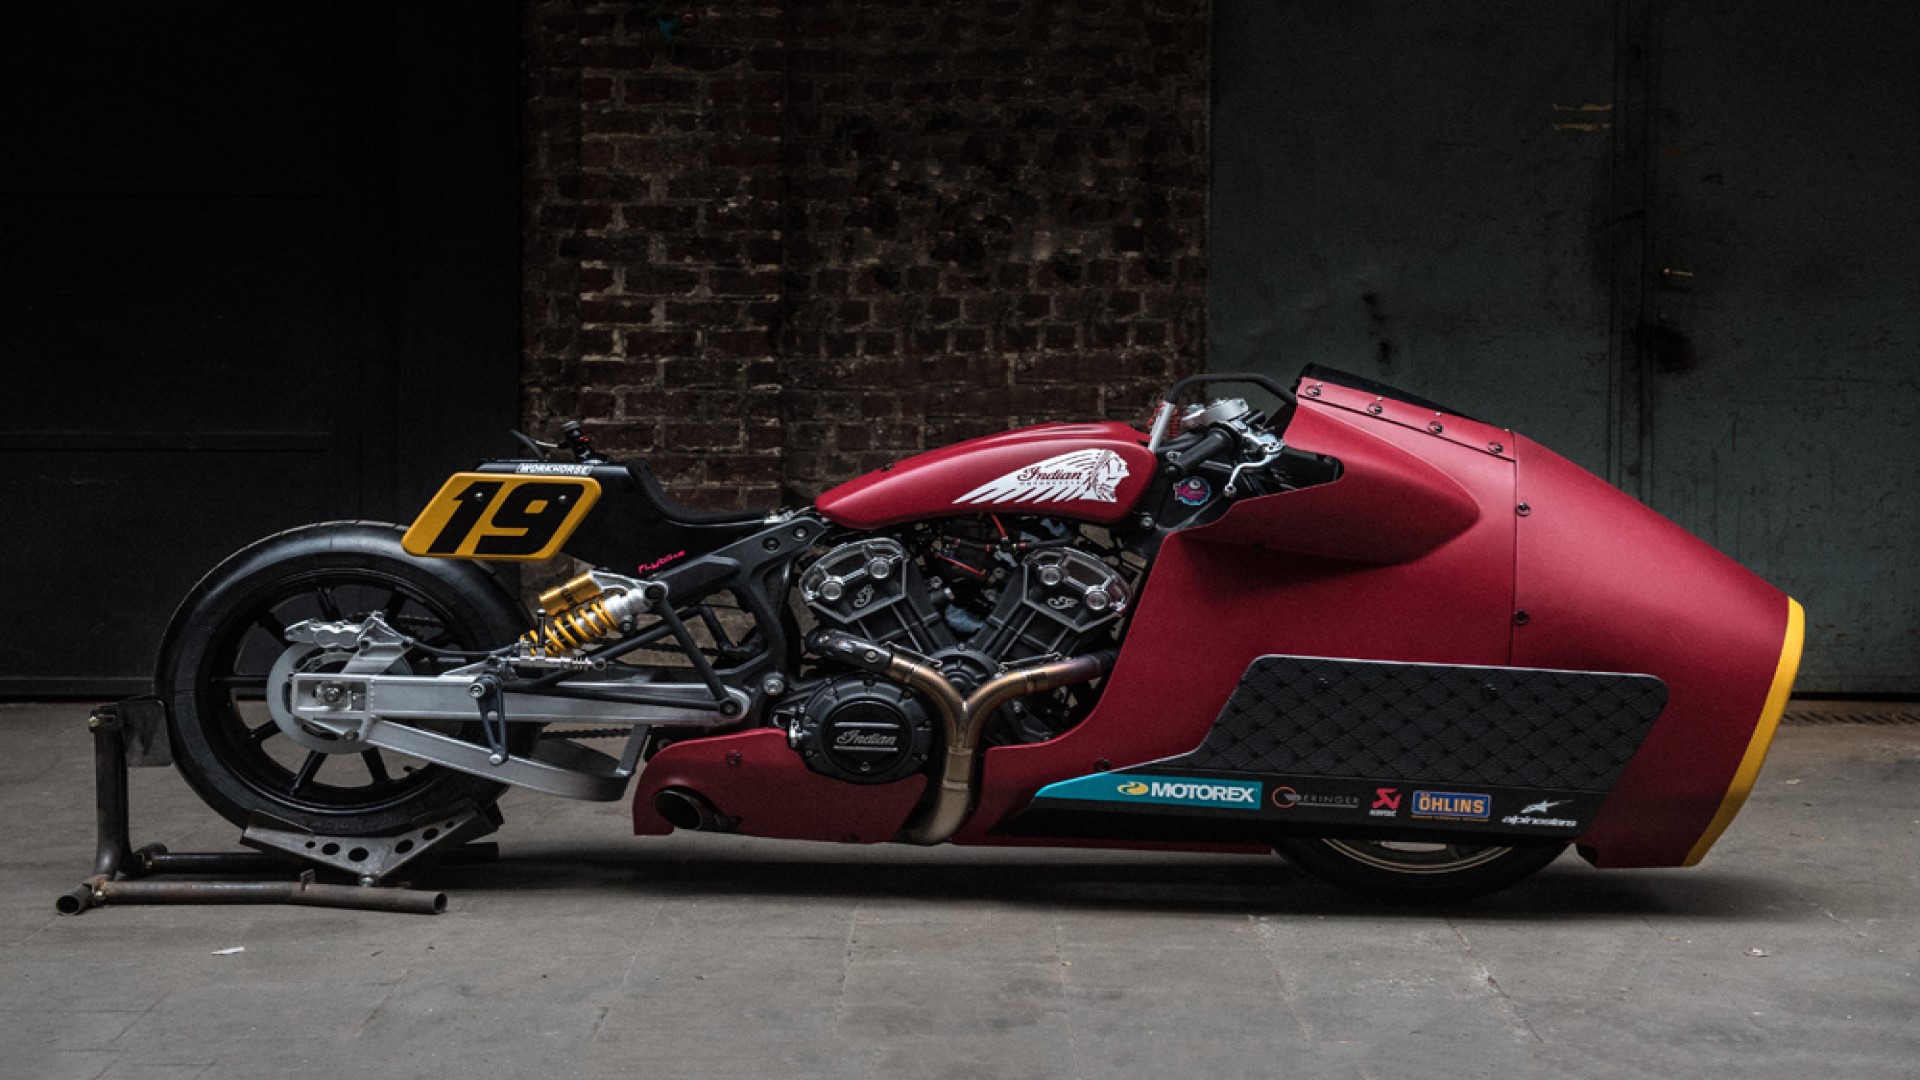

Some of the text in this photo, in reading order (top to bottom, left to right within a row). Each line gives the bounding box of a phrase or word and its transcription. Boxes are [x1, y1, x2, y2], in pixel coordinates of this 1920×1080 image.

[517, 464, 591, 476] WORKHORSE
[1017, 466, 1082, 481] Indian
[426, 481, 585, 555] 19
[836, 729, 898, 746] Indian
[1151, 781, 1255, 803] MOTOREX
[1418, 792, 1485, 814] ÖHLINS
